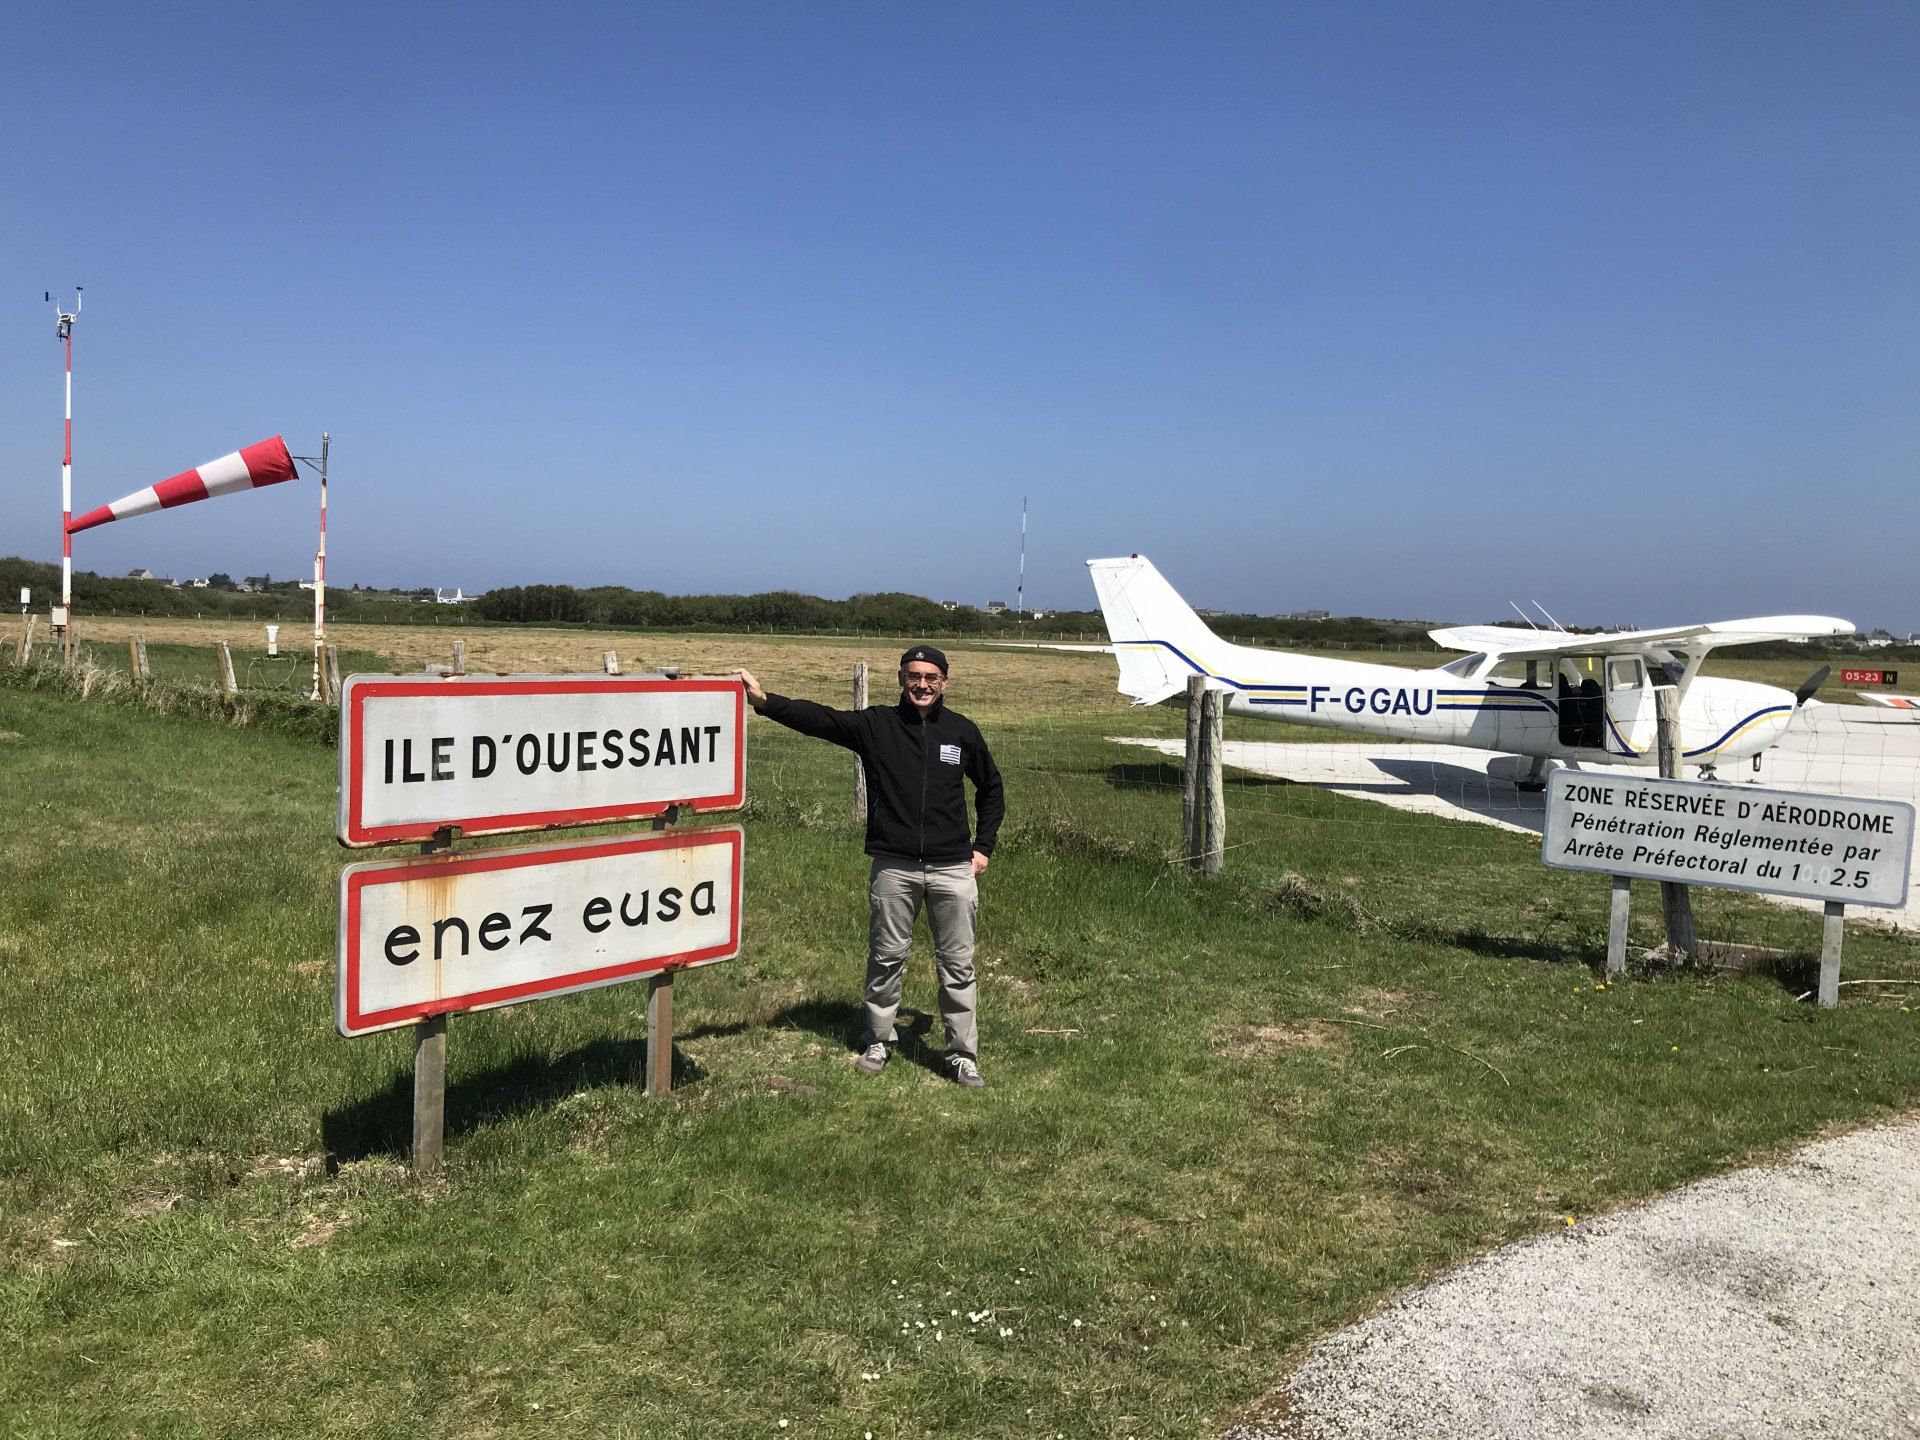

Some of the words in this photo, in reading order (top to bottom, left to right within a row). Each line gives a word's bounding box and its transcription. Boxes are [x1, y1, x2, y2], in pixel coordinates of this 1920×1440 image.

[1845, 672, 1879, 682] 05-23
[1886, 674, 1894, 682] N
[1310, 686, 1433, 716] F-GGAU
[384, 737, 455, 784] ILE
[472, 726, 721, 779] D'OUESSANT
[1565, 784, 1614, 806] ZONE
[1625, 788, 1726, 817] RÉSERVÉE
[1738, 801, 1894, 834] D'AÉRODROME
[1564, 838, 1624, 861] Arrête
[1632, 846, 1747, 876] Préfectoral
[1756, 861, 1782, 879] du
[1571, 812, 1685, 840] Pénétration
[1694, 825, 1833, 857] Réglementée
[1843, 845, 1881, 863] par
[384, 903, 553, 966] enez
[582, 880, 716, 934] eusa
